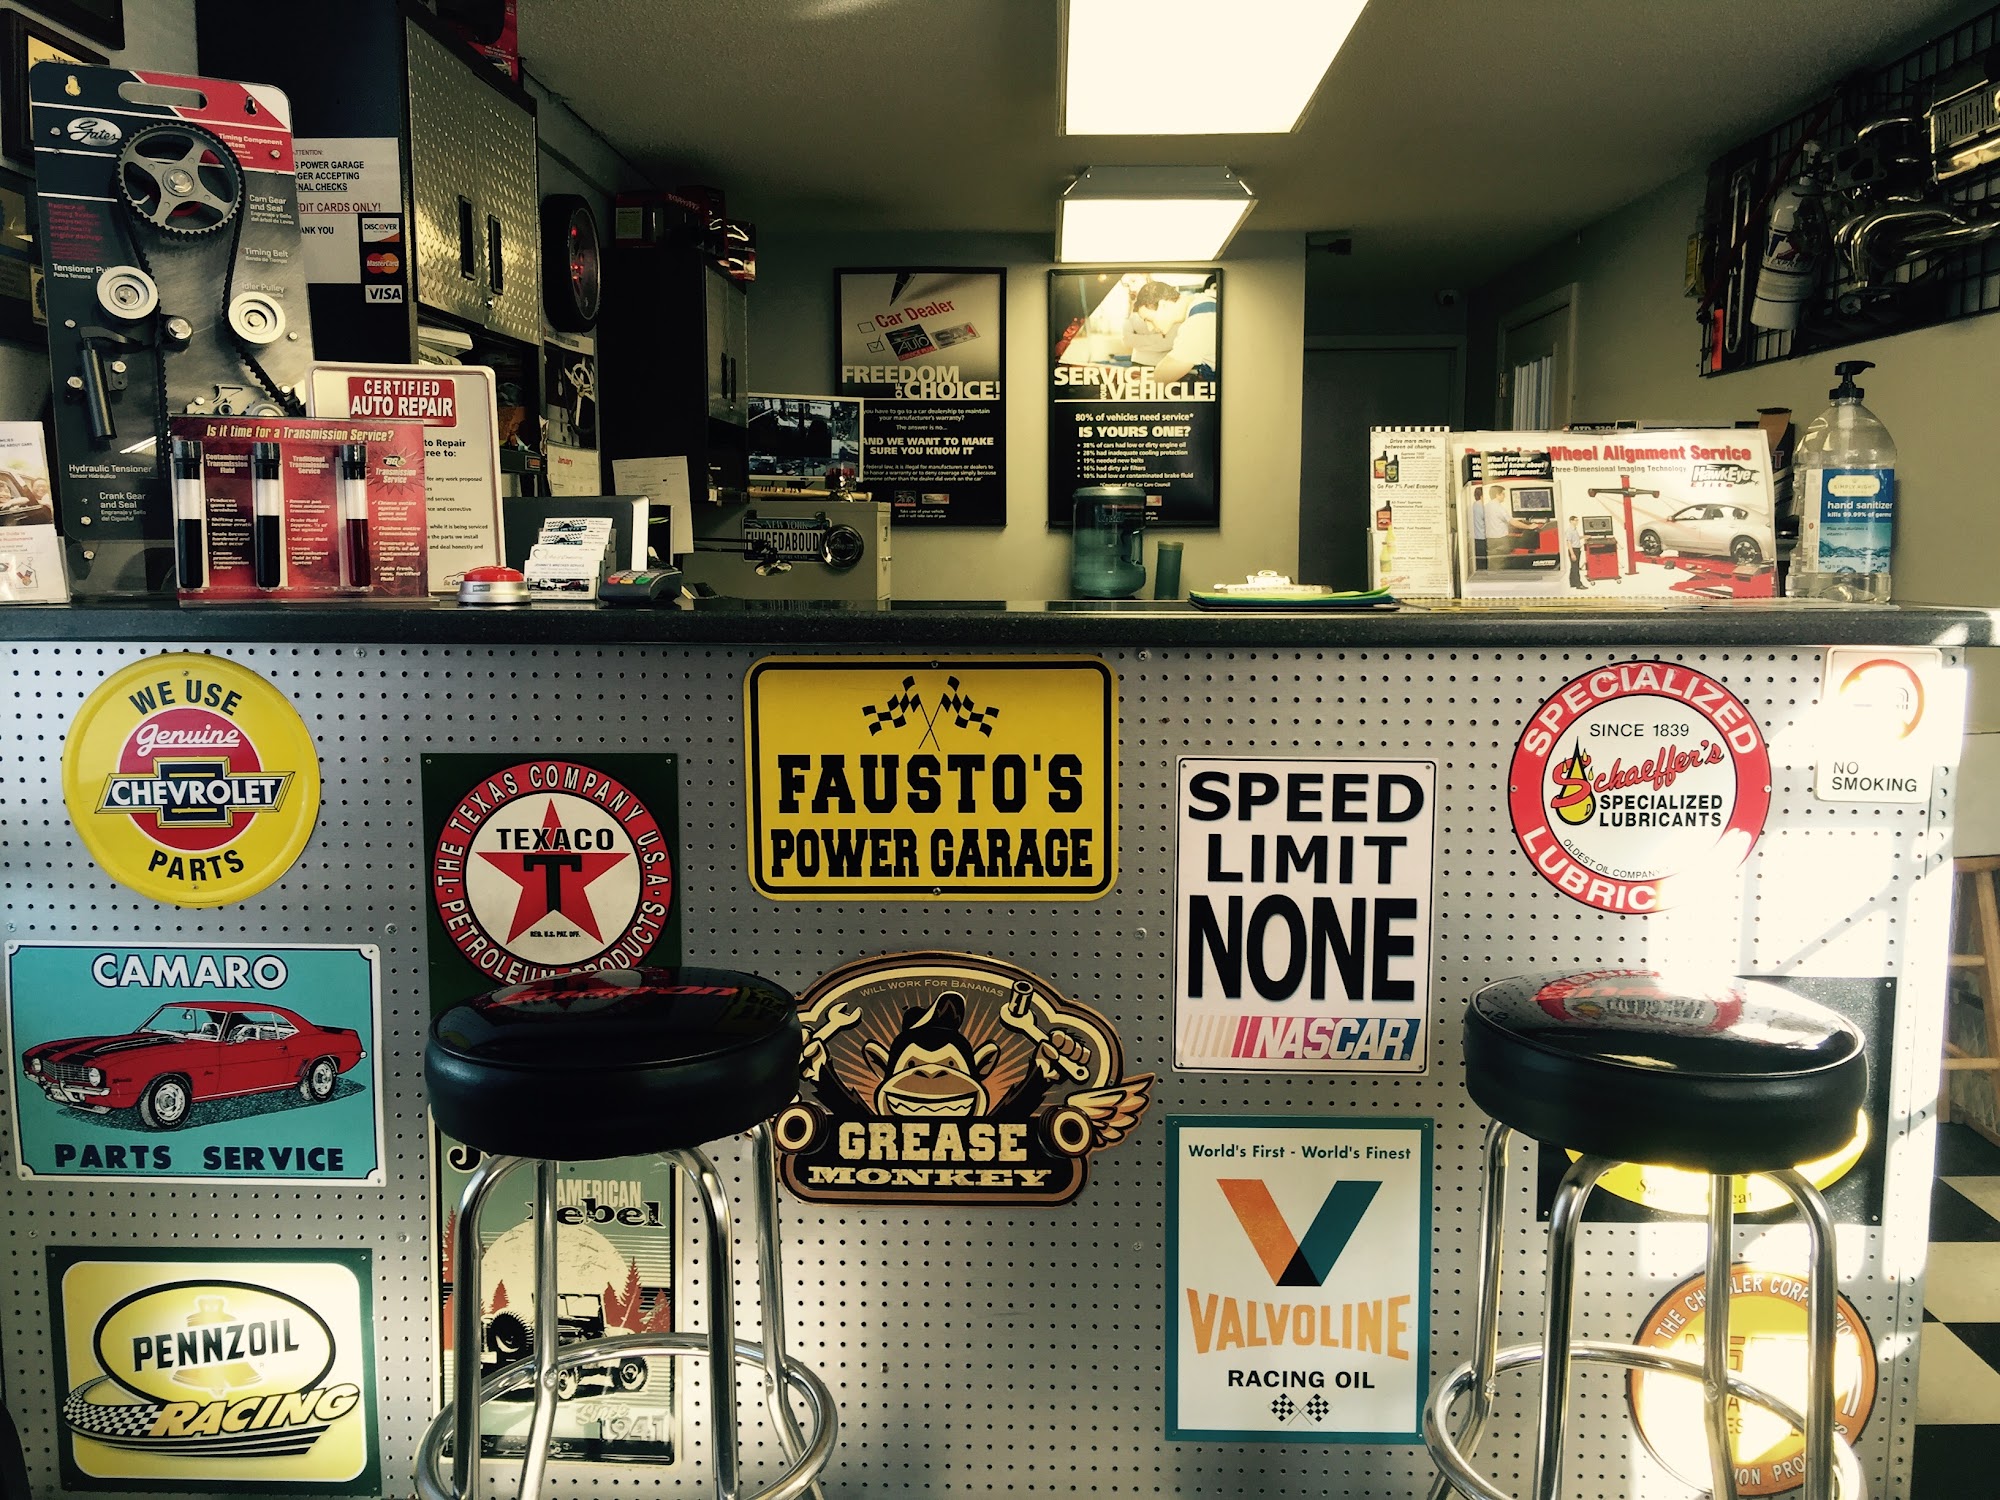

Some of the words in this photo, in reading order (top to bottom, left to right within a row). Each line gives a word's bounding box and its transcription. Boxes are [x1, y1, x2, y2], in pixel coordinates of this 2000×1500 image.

[74, 120, 121, 144] Gates
[218, 133, 242, 142] Timing
[243, 135, 283, 146] Component
[300, 161, 329, 169] POWER
[331, 161, 364, 169] GARAGE
[315, 172, 360, 180] ACCEPTING
[316, 183, 348, 191] CHECKS
[249, 194, 267, 204] Cam
[269, 196, 286, 204] Gear
[267, 204, 283, 212] Seal
[316, 203, 350, 212] CARDS
[353, 203, 382, 212] ONLY!
[318, 226, 334, 234] YOU
[364, 223, 398, 231] DISCOVER
[245, 247, 271, 257] Timing
[273, 249, 288, 258] Belt
[52, 263, 95, 273] Tensioner
[366, 260, 400, 268] MasterCard
[369, 287, 401, 300] VISA
[874, 311, 903, 328] Car
[904, 300, 955, 321] Dealer
[898, 337, 930, 354] AUTO
[842, 366, 960, 383] FREEDOM
[1054, 366, 1155, 386] SERVICE
[364, 379, 440, 397] CERTIFIED
[904, 380, 1000, 398] CHOICE!
[1107, 382, 1216, 400] VEHICLE!
[350, 396, 394, 416] AUTO
[398, 397, 454, 417] REPAIR
[1075, 413, 1094, 422] 80%
[1096, 413, 1106, 422] of
[1106, 413, 1138, 422] vehicles
[1140, 413, 1160, 422] need
[206, 424, 216, 437] Is
[219, 424, 228, 438] it
[230, 424, 252, 438] time
[255, 426, 270, 438] for
[274, 428, 280, 438] a
[284, 427, 348, 441] Transmission
[350, 429, 394, 442] Service?
[1078, 426, 1092, 438] IS
[1096, 426, 1148, 438] YOURS
[1152, 426, 1192, 438] ONE?
[436, 438, 466, 448] Repair
[864, 437, 884, 446] AND
[886, 437, 904, 446] WE
[907, 437, 941, 446] WANT
[943, 437, 959, 446] TO
[962, 437, 994, 446] MAKE
[870, 446, 898, 455] SURE
[901, 446, 924, 455] YOU
[926, 446, 960, 455] KNOW
[962, 446, 974, 455] IT
[444, 449, 457, 458] to:
[1547, 446, 1598, 461] Wheel
[1603, 445, 1686, 464] Alignment
[1690, 444, 1752, 461] Service
[68, 464, 110, 474] Hydraulic
[111, 464, 152, 473] Tensioner
[376, 468, 416, 476] Transmission
[1552, 465, 1616, 473] Three-Dimensional
[1618, 466, 1646, 474] Imaging
[1648, 466, 1688, 474] Technology
[1692, 466, 1752, 482] HawkEye
[383, 476, 406, 484] Service
[99, 492, 125, 500] Crank
[126, 492, 146, 500] Gear
[1827, 501, 1854, 510] hand
[1856, 501, 1892, 510] sanitizer
[766, 520, 784, 529] NEW
[785, 520, 808, 530] YORK
[128, 681, 175, 715] WE
[186, 680, 242, 716] USE
[1524, 665, 1758, 758] SPECIALIZED
[1590, 724, 1644, 738] SINCE
[1652, 724, 1690, 738] 1839
[136, 724, 241, 757] Genuine
[1551, 739, 1725, 810] Schaeffer's
[1834, 762, 1859, 774] NO
[777, 753, 1083, 814] FAUSTO'S
[1832, 776, 1918, 792] SMOKING
[111, 780, 276, 806] CHEVROLET
[530, 765, 644, 823] COMPANY
[1188, 771, 1424, 822] SPEED
[450, 772, 518, 834] TEXAS
[1600, 795, 1723, 810] SPECIALIZED
[1600, 812, 1722, 828] LUBRICANTS
[496, 828, 614, 850] TEXACO
[770, 828, 919, 878] POWER
[930, 828, 1093, 878] GARAGE
[1208, 834, 1407, 884] LIMIT
[1563, 838, 1596, 867] OLDEST
[1596, 863, 1610, 876] OIL
[148, 850, 244, 882] PARTS
[438, 842, 464, 886] THE
[1522, 826, 1658, 911] LUBRIC
[1188, 894, 1418, 1002] NONE
[92, 954, 288, 990] CAMARO
[859, 986, 887, 998] WILL
[888, 980, 922, 990] WORK
[924, 979, 948, 988] FOR
[951, 979, 1004, 998] BANANAS
[1252, 1016, 1411, 1060] NASCAR
[838, 1122, 1028, 1162] GREASE
[55, 1144, 172, 1169] PARTS
[203, 1146, 344, 1171] SERVICE
[1188, 1144, 1246, 1158] World's
[1252, 1144, 1286, 1158] First
[1302, 1146, 1360, 1160] World's
[1366, 1146, 1412, 1160] Finest
[808, 1166, 1053, 1187] MONKEY
[557, 1178, 642, 1208] AMERICAN
[1186, 1288, 1411, 1361] VALVOLINE
[1655, 1308, 1686, 1341] THE
[133, 1318, 299, 1372] PENNZOIL
[1228, 1369, 1325, 1388] RACING
[1335, 1370, 1375, 1389] OIL
[149, 1383, 360, 1437] RACING
[601, 1413, 671, 1442] 1941
